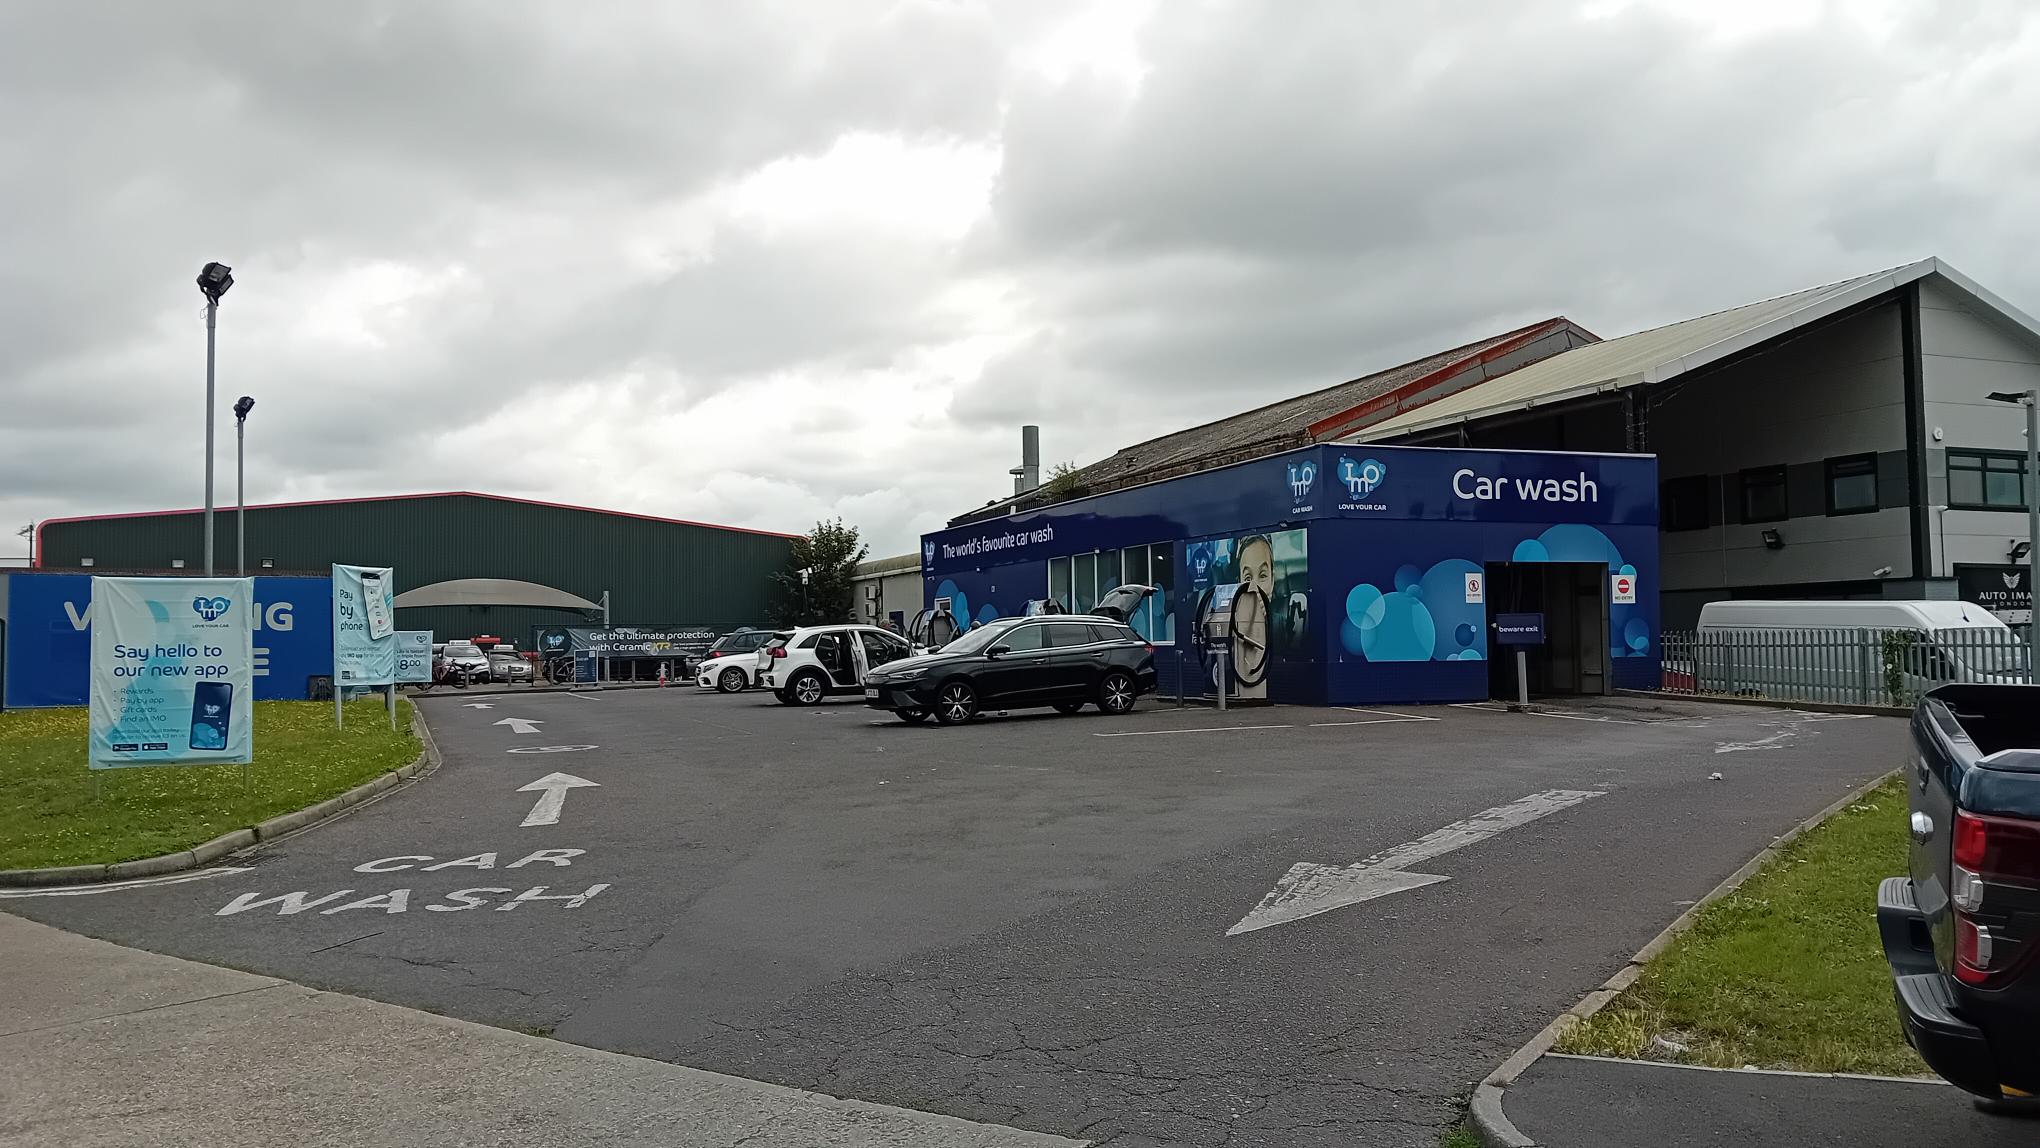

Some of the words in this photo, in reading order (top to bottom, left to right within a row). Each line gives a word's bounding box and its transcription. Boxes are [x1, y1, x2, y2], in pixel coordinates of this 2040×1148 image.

[1453, 468, 1508, 500] Car
[1516, 472, 1598, 502] wash
[943, 544, 955, 559] The
[956, 538, 981, 556] world's
[982, 532, 1015, 552] favourite
[1016, 532, 1029, 546] car
[1030, 523, 1054, 543] wash
[340, 589, 353, 601] Pay
[1979, 592, 2007, 600] AUTO
[2012, 592, 2032, 600] IMA
[340, 603, 353, 619] by
[340, 621, 363, 632] phone
[589, 632, 607, 640] Get
[609, 632, 625, 640] the
[626, 632, 665, 640] ultimate
[667, 631, 715, 641] protection
[114, 645, 149, 662] Say
[155, 644, 198, 658] hello
[204, 645, 222, 657] to
[589, 643, 610, 651] with
[612, 642, 651, 651] Ceramic
[114, 666, 145, 677] our
[151, 666, 189, 676] new
[194, 665, 228, 678] app
[353, 849, 587, 874] CAR
[214, 884, 612, 916] WASH
